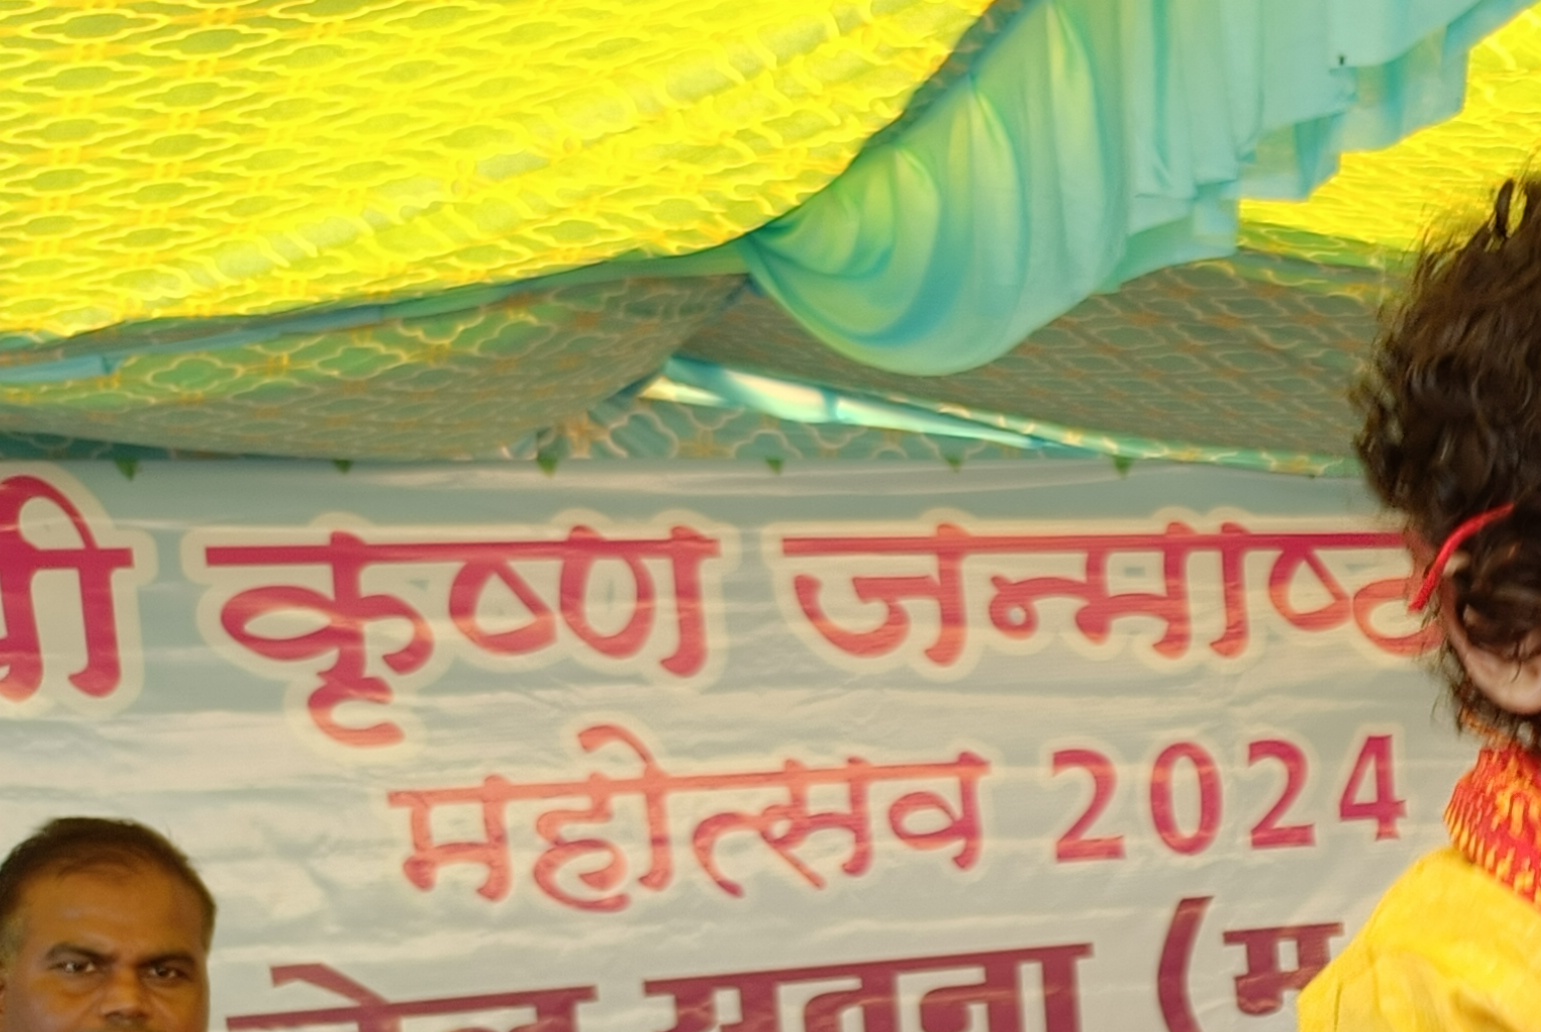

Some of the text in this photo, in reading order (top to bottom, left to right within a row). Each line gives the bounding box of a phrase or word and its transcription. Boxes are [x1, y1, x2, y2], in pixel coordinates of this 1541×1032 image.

[205, 525, 722, 748] कृष्ण
[782, 522, 1446, 667] जन्माष्ट
[387, 724, 1407, 912] महोत्सव 2024
